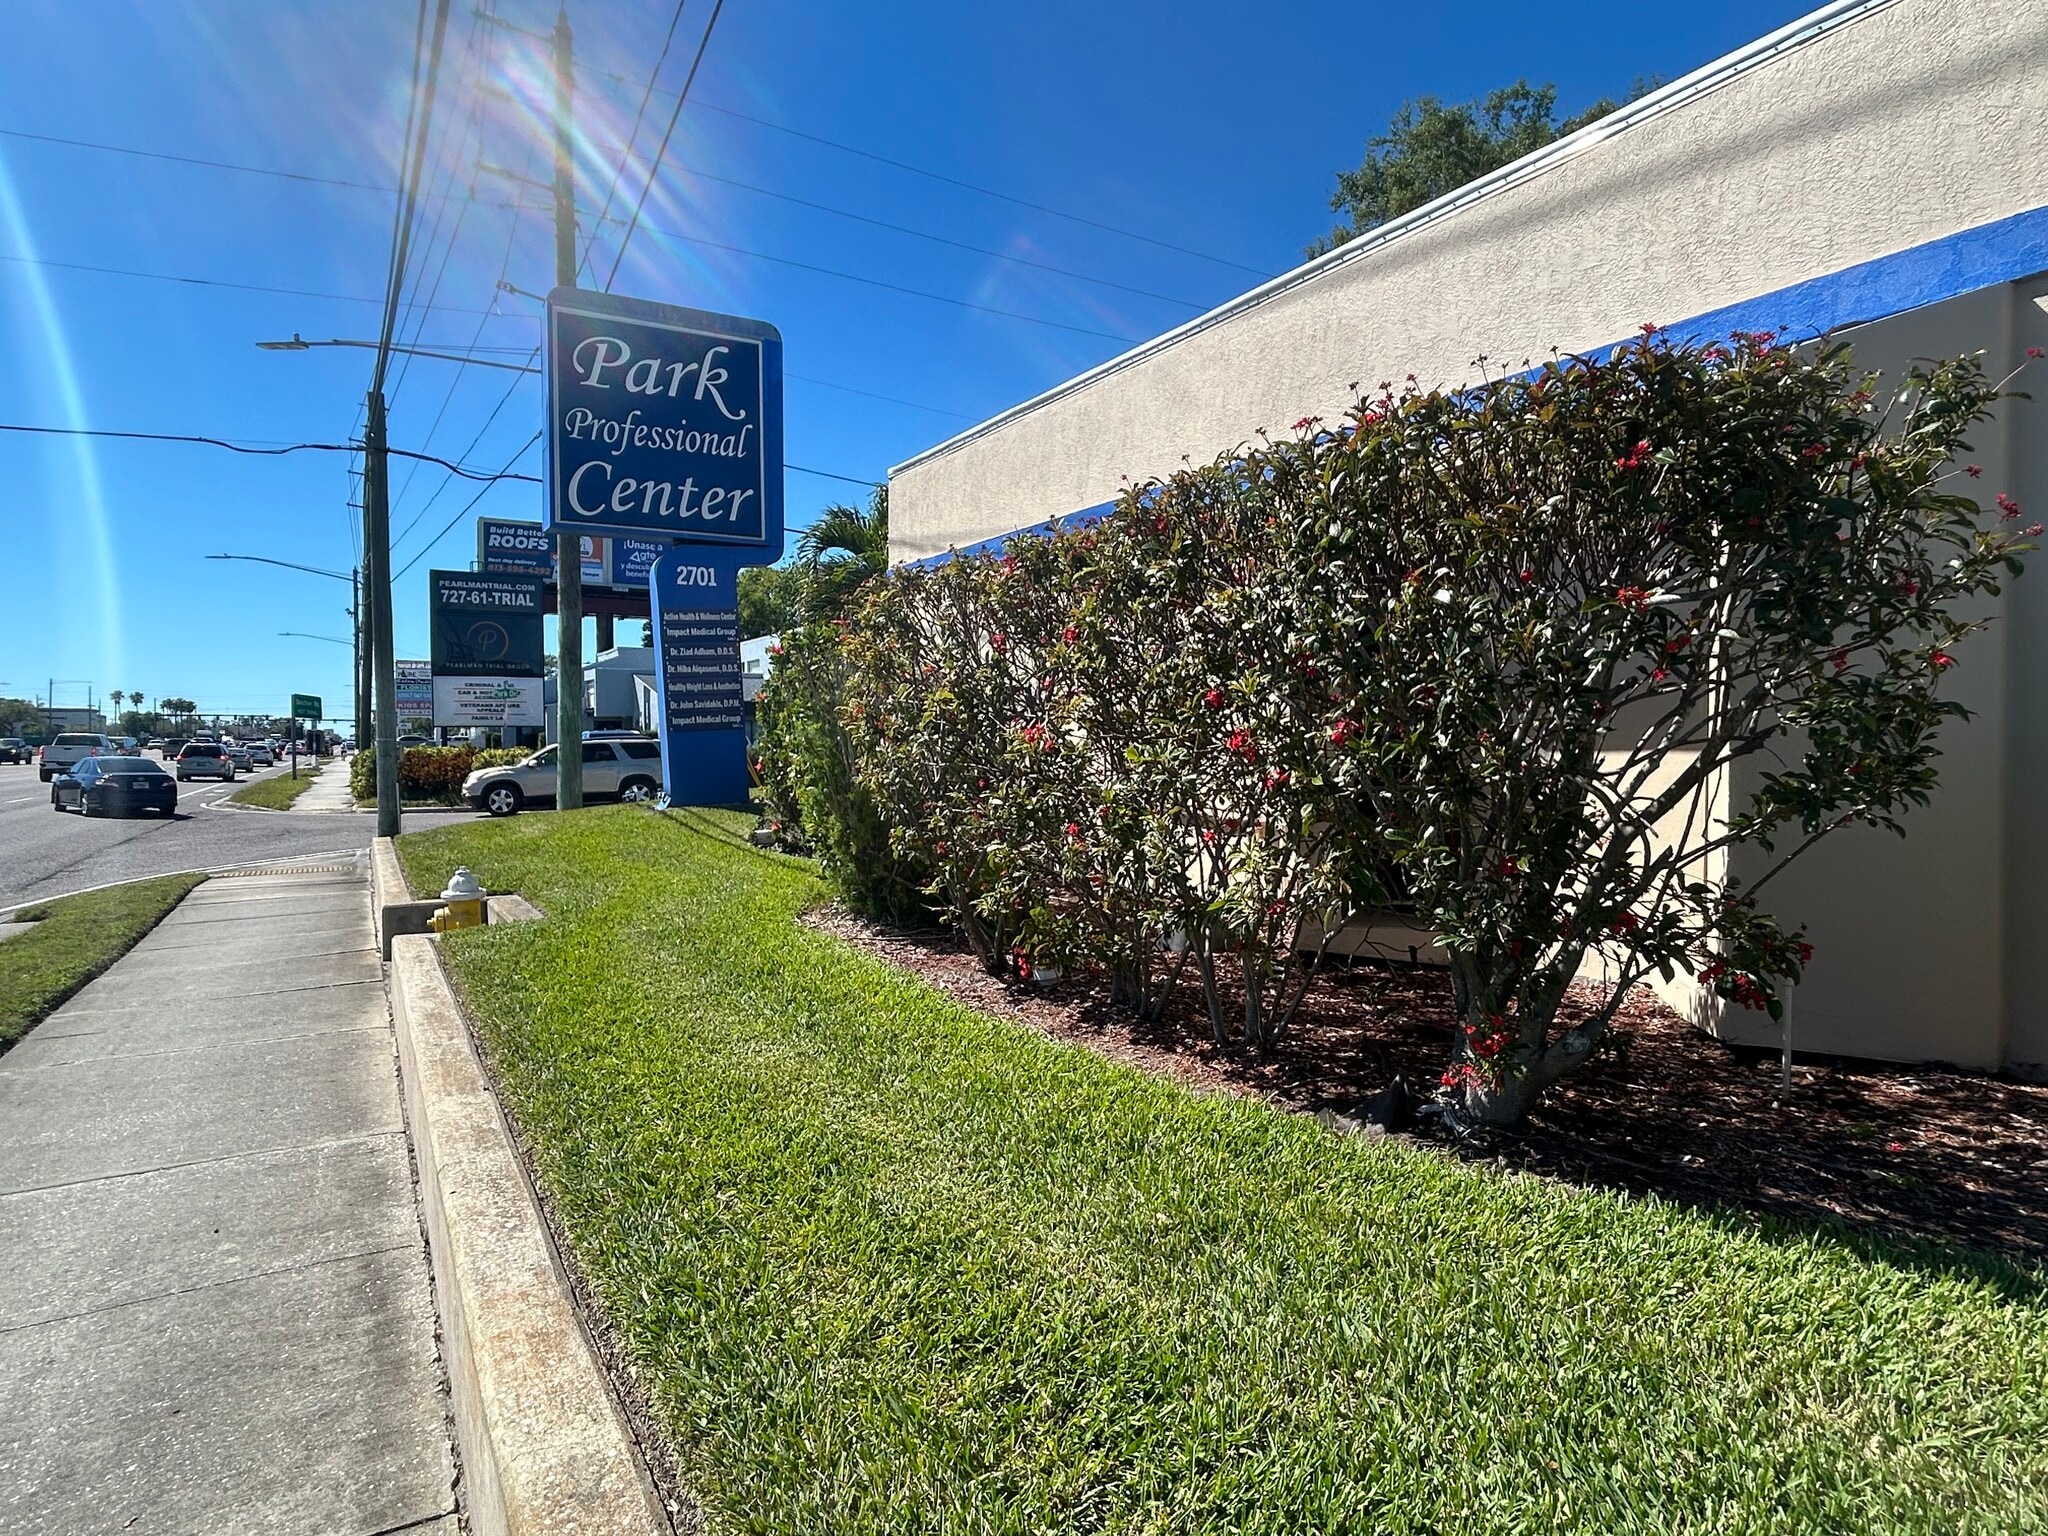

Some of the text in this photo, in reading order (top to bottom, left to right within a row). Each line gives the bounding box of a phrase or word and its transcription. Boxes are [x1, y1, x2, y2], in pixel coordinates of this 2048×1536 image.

[572, 336, 746, 421] Park
[565, 407, 753, 458] Professional
[568, 460, 754, 522] Center
[490, 526, 515, 535] Build
[488, 534, 549, 550] ROOFS
[676, 566, 717, 586] 2701
[440, 580, 536, 591] PEARLMANTRIAL.COM
[440, 590, 534, 606] 727-61-TRIAL
[720, 612, 736, 620] Center
[666, 628, 736, 638] Impact Medical Group
[670, 648, 680, 656] Dr.
[680, 648, 694, 656] Ziad
[718, 647, 736, 656] D.D.S.
[668, 664, 677, 672] Dr.
[722, 664, 739, 672] D.D.S.
[680, 700, 693, 709] John
[672, 714, 741, 726] Impact Medical Group
